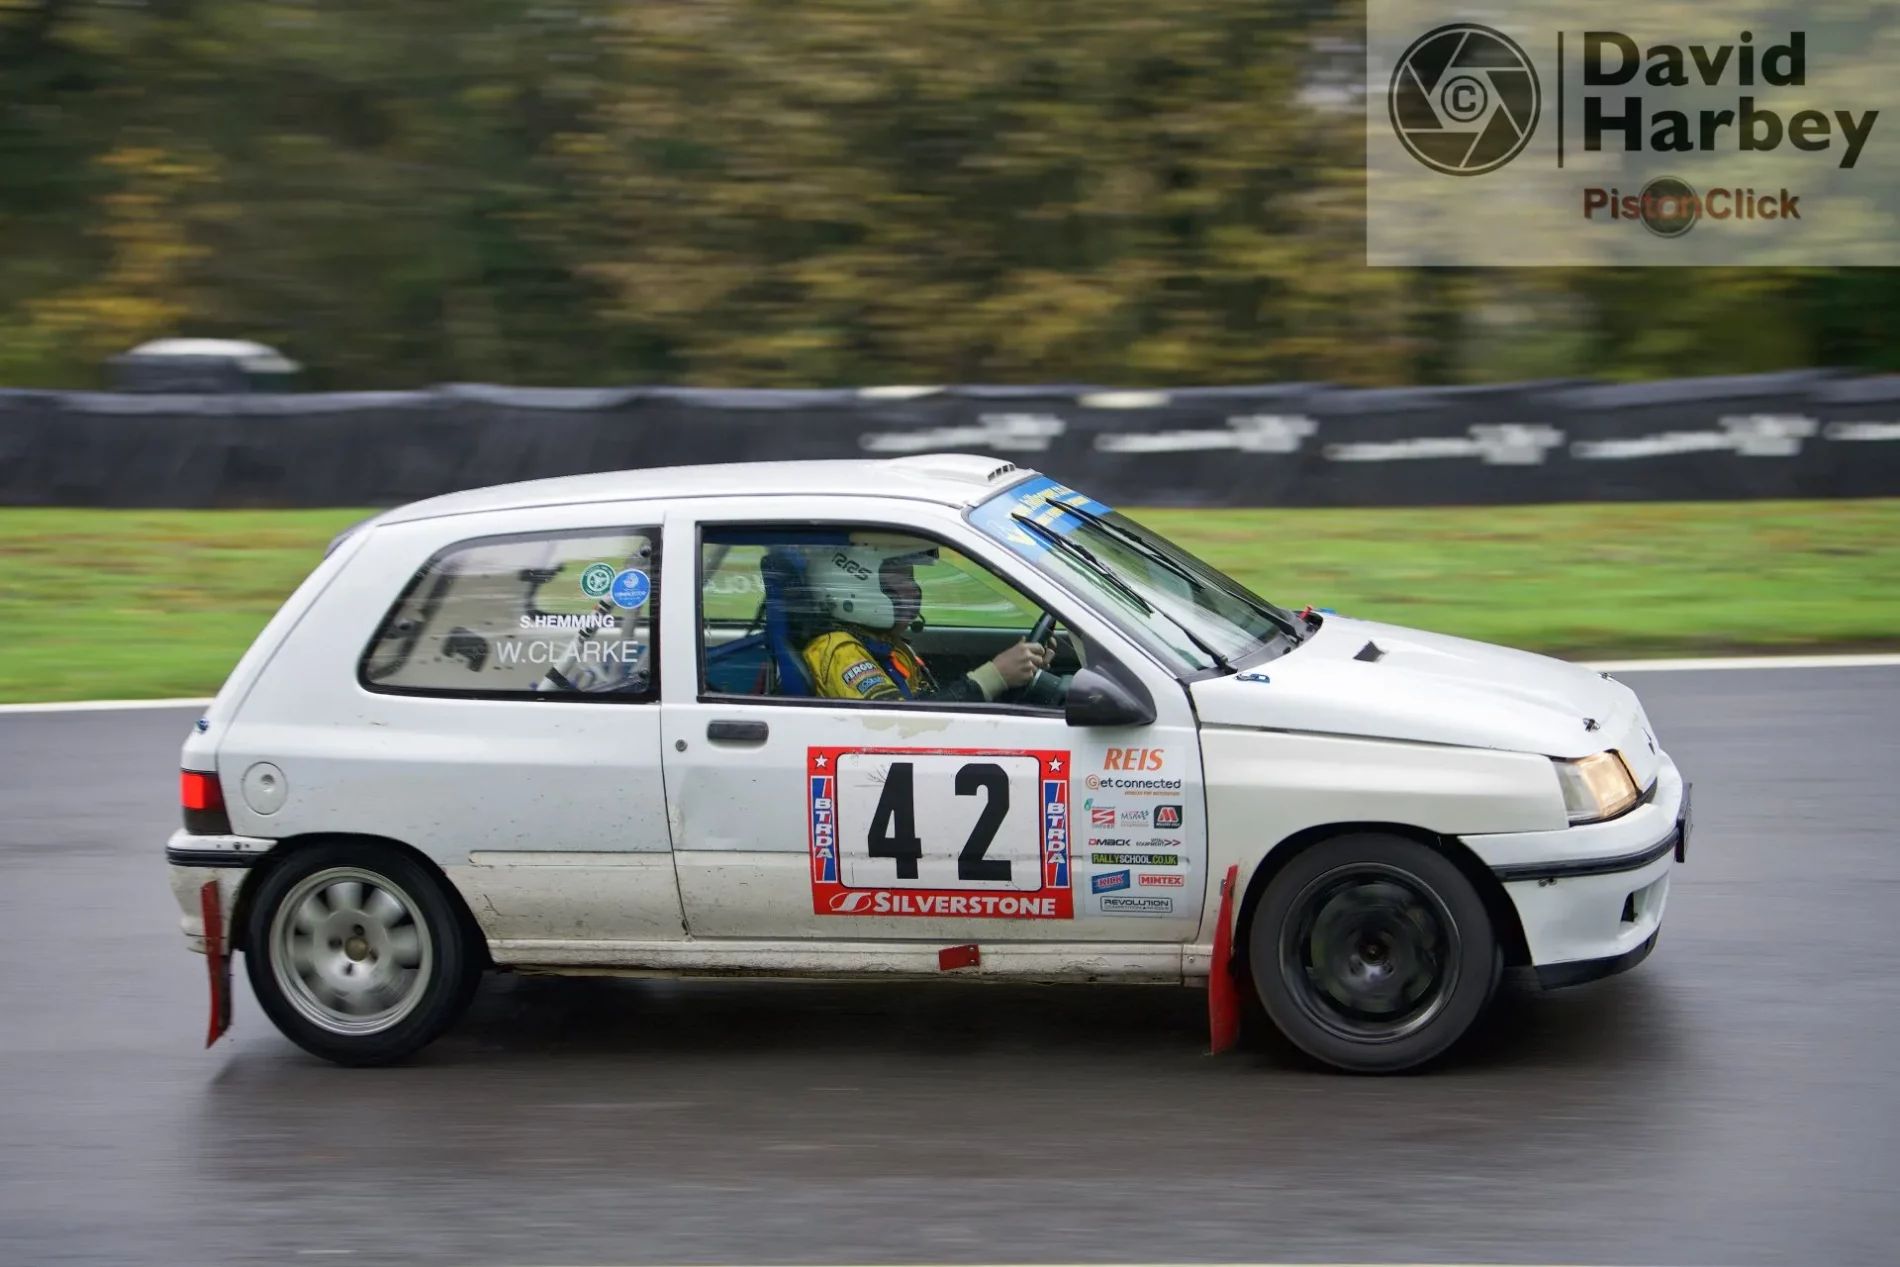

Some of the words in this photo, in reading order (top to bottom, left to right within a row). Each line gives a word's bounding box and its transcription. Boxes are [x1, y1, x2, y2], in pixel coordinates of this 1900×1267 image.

[519, 614, 615, 629] S.HEMMING
[497, 640, 639, 663] W.CLARKE
[1103, 747, 1164, 771] REIS
[1115, 779, 1181, 789] connected
[814, 798, 833, 859] BTRDA
[867, 762, 1012, 881] 42
[1047, 802, 1066, 864] BTRDA
[1093, 854, 1176, 865] RALLYSCHOOL.CO.UK
[1141, 876, 1181, 885] MINTEX
[873, 892, 1056, 916] SILVERSTONE
